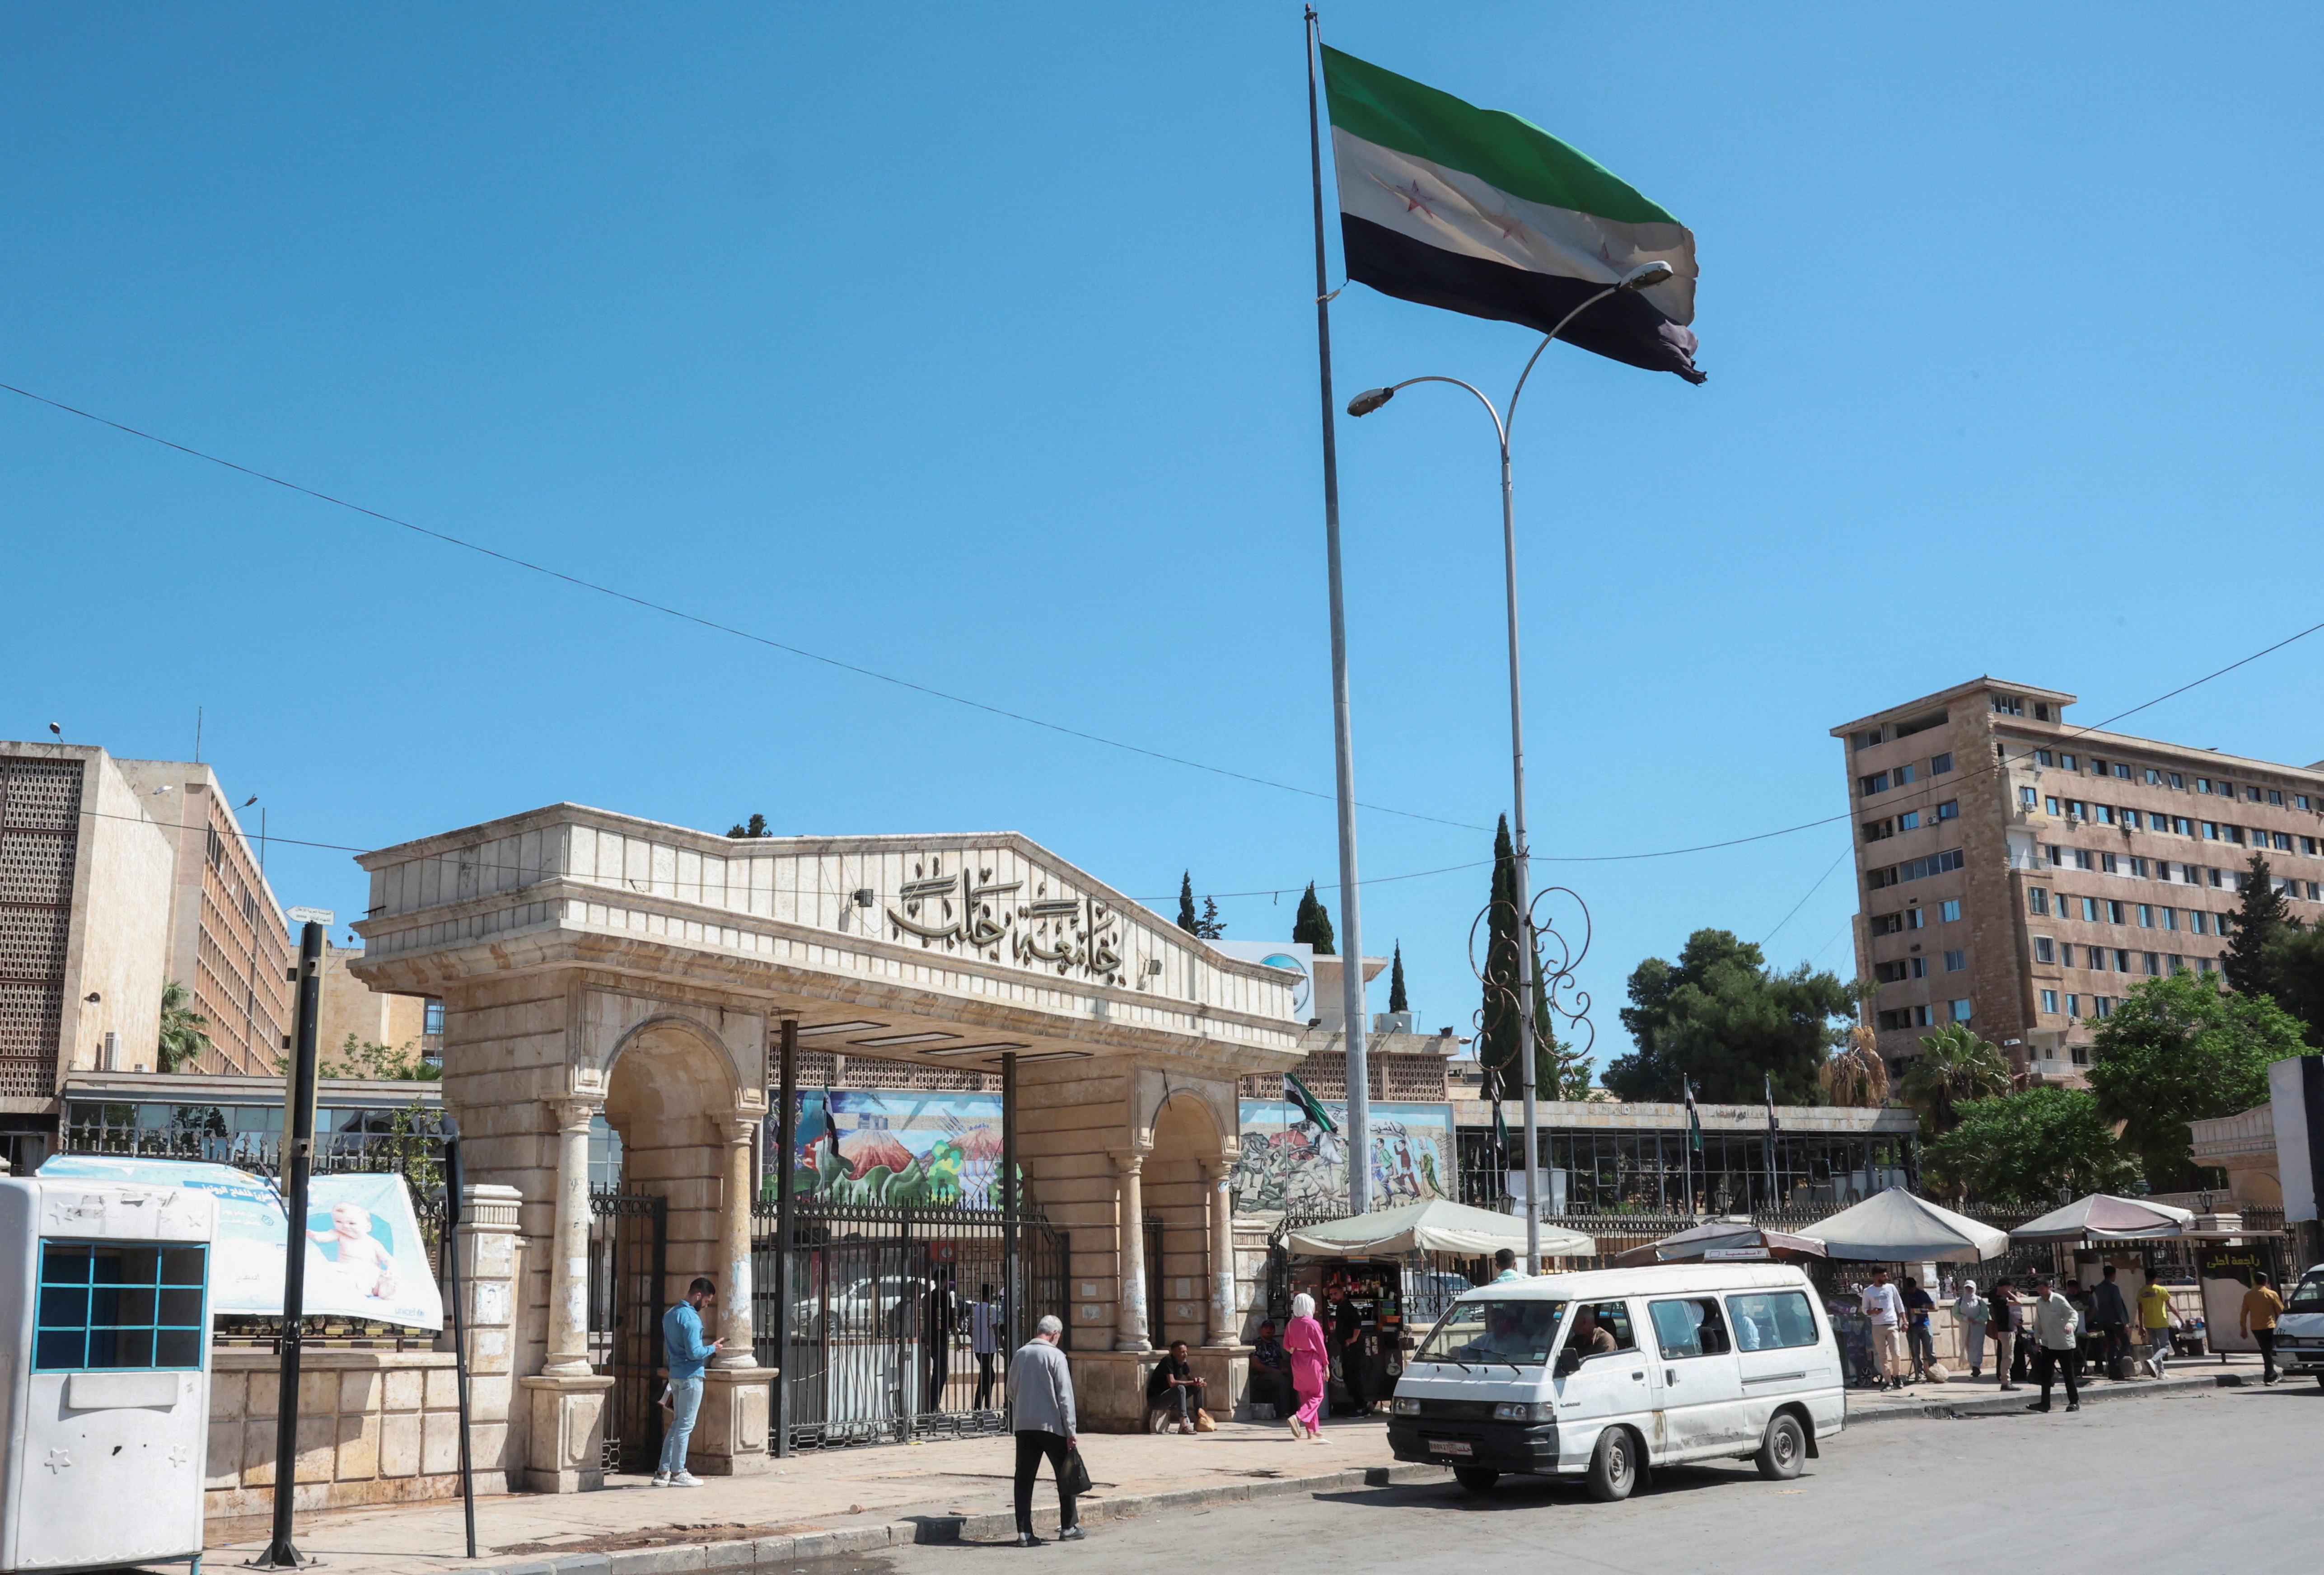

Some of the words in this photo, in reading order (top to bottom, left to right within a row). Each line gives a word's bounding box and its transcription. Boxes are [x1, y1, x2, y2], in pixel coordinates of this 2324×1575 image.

[887, 857, 1022, 958] حلب
[1013, 883, 1126, 984] جامعة
[395, 1307, 416, 1316] unicef
